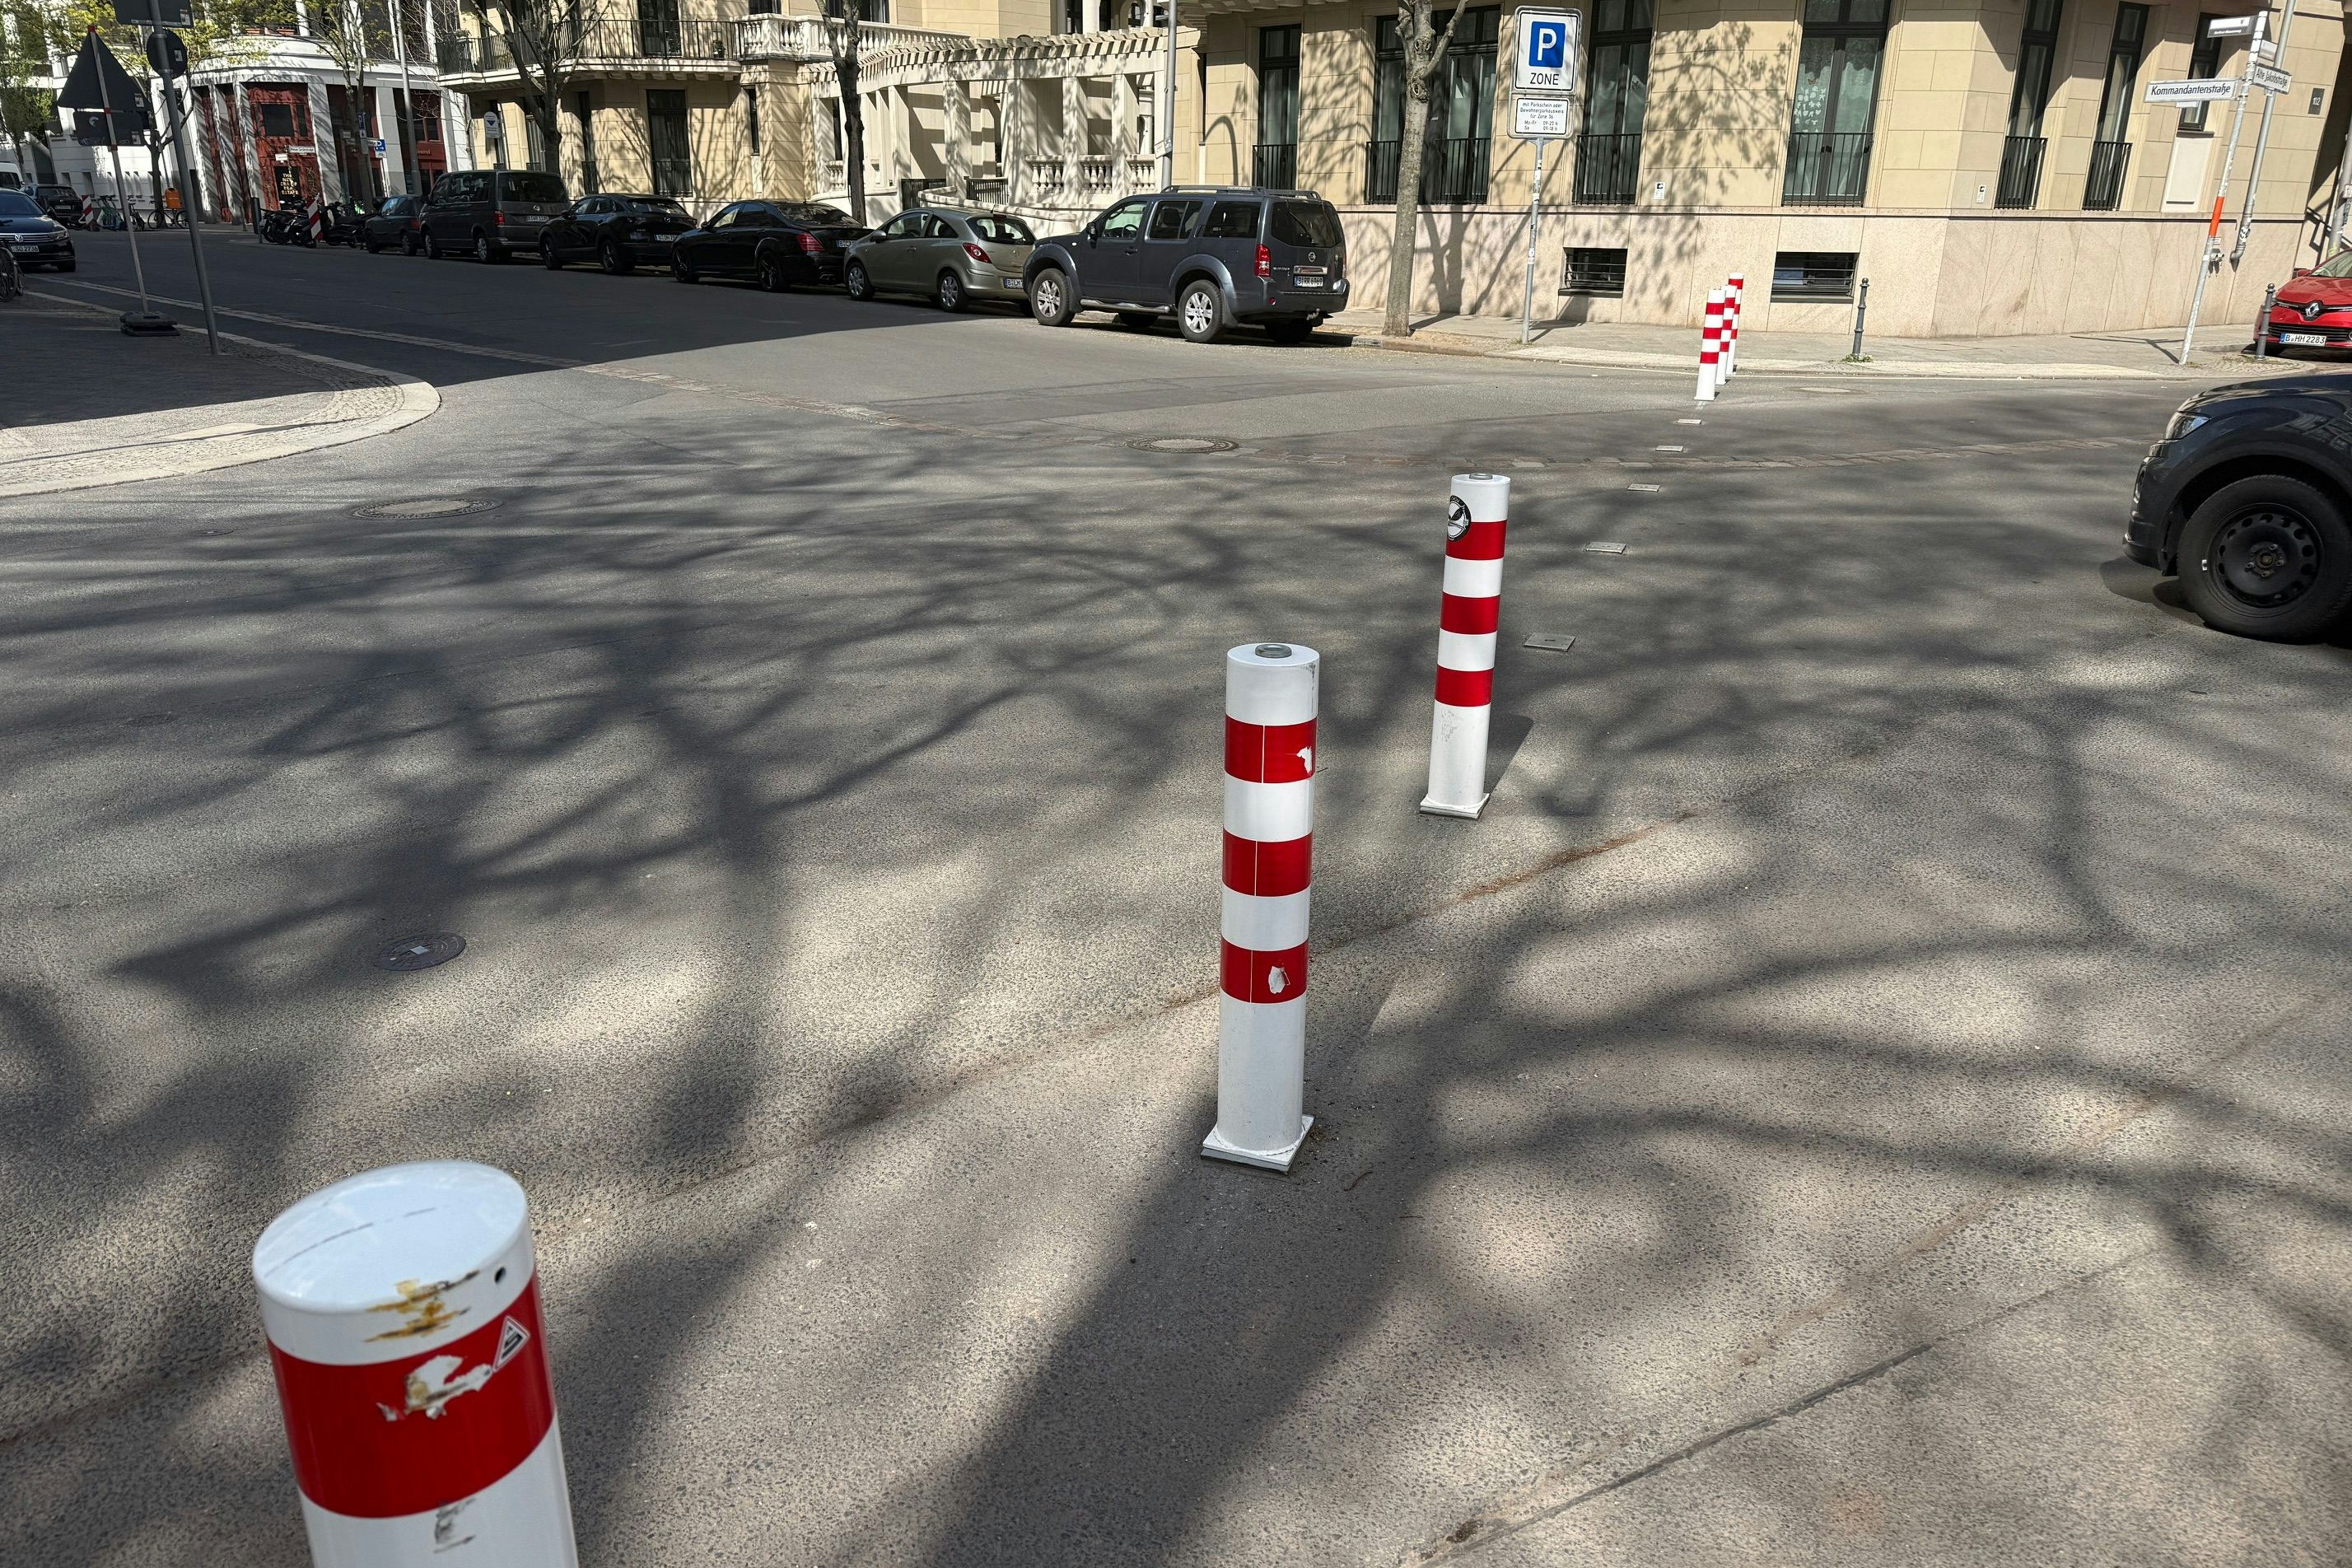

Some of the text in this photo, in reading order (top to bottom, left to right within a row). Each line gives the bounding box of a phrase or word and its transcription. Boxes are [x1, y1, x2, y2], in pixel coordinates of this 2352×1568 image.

[1537, 28, 1557, 61] P
[1529, 72, 1560, 86] ZONE
[2256, 68, 2265, 80] Alte
[2150, 82, 2231, 96] Kommandantenstraße
